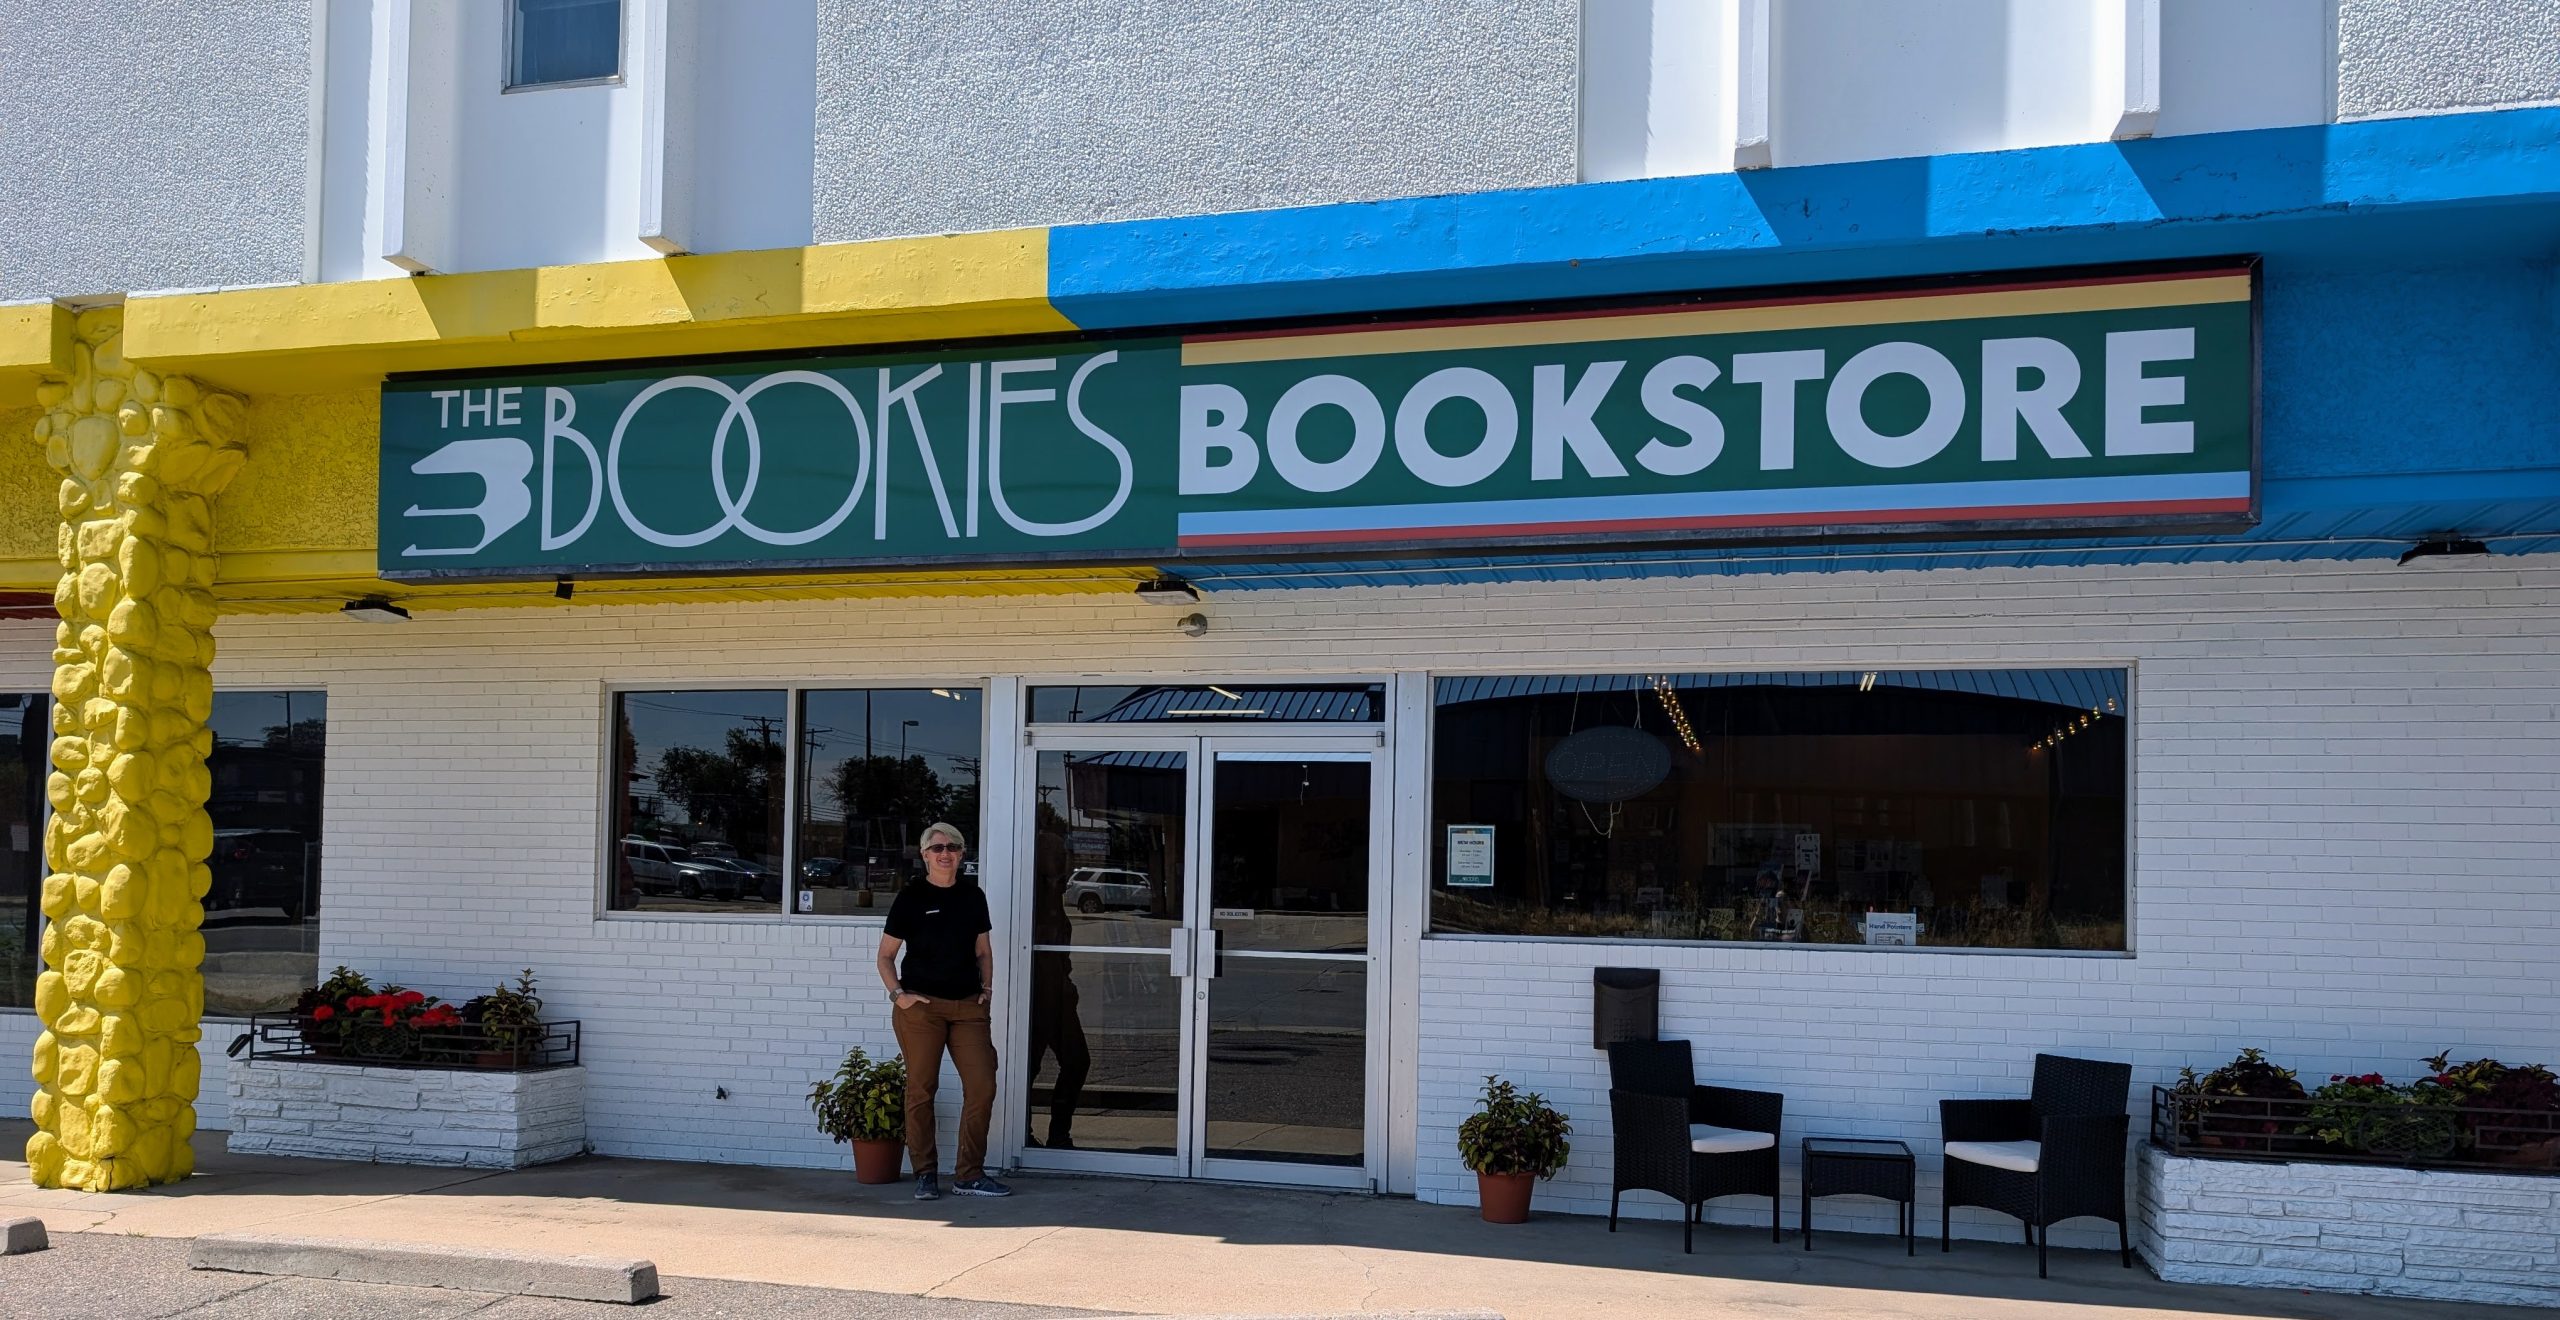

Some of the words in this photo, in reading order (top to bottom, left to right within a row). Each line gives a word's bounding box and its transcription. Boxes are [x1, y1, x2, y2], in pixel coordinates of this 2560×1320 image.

[431, 387, 522, 429] THE
[541, 349, 1134, 551] BOOKIES
[1179, 326, 2196, 496] BOOKSTORE
[1554, 752, 1659, 779] OPEN
